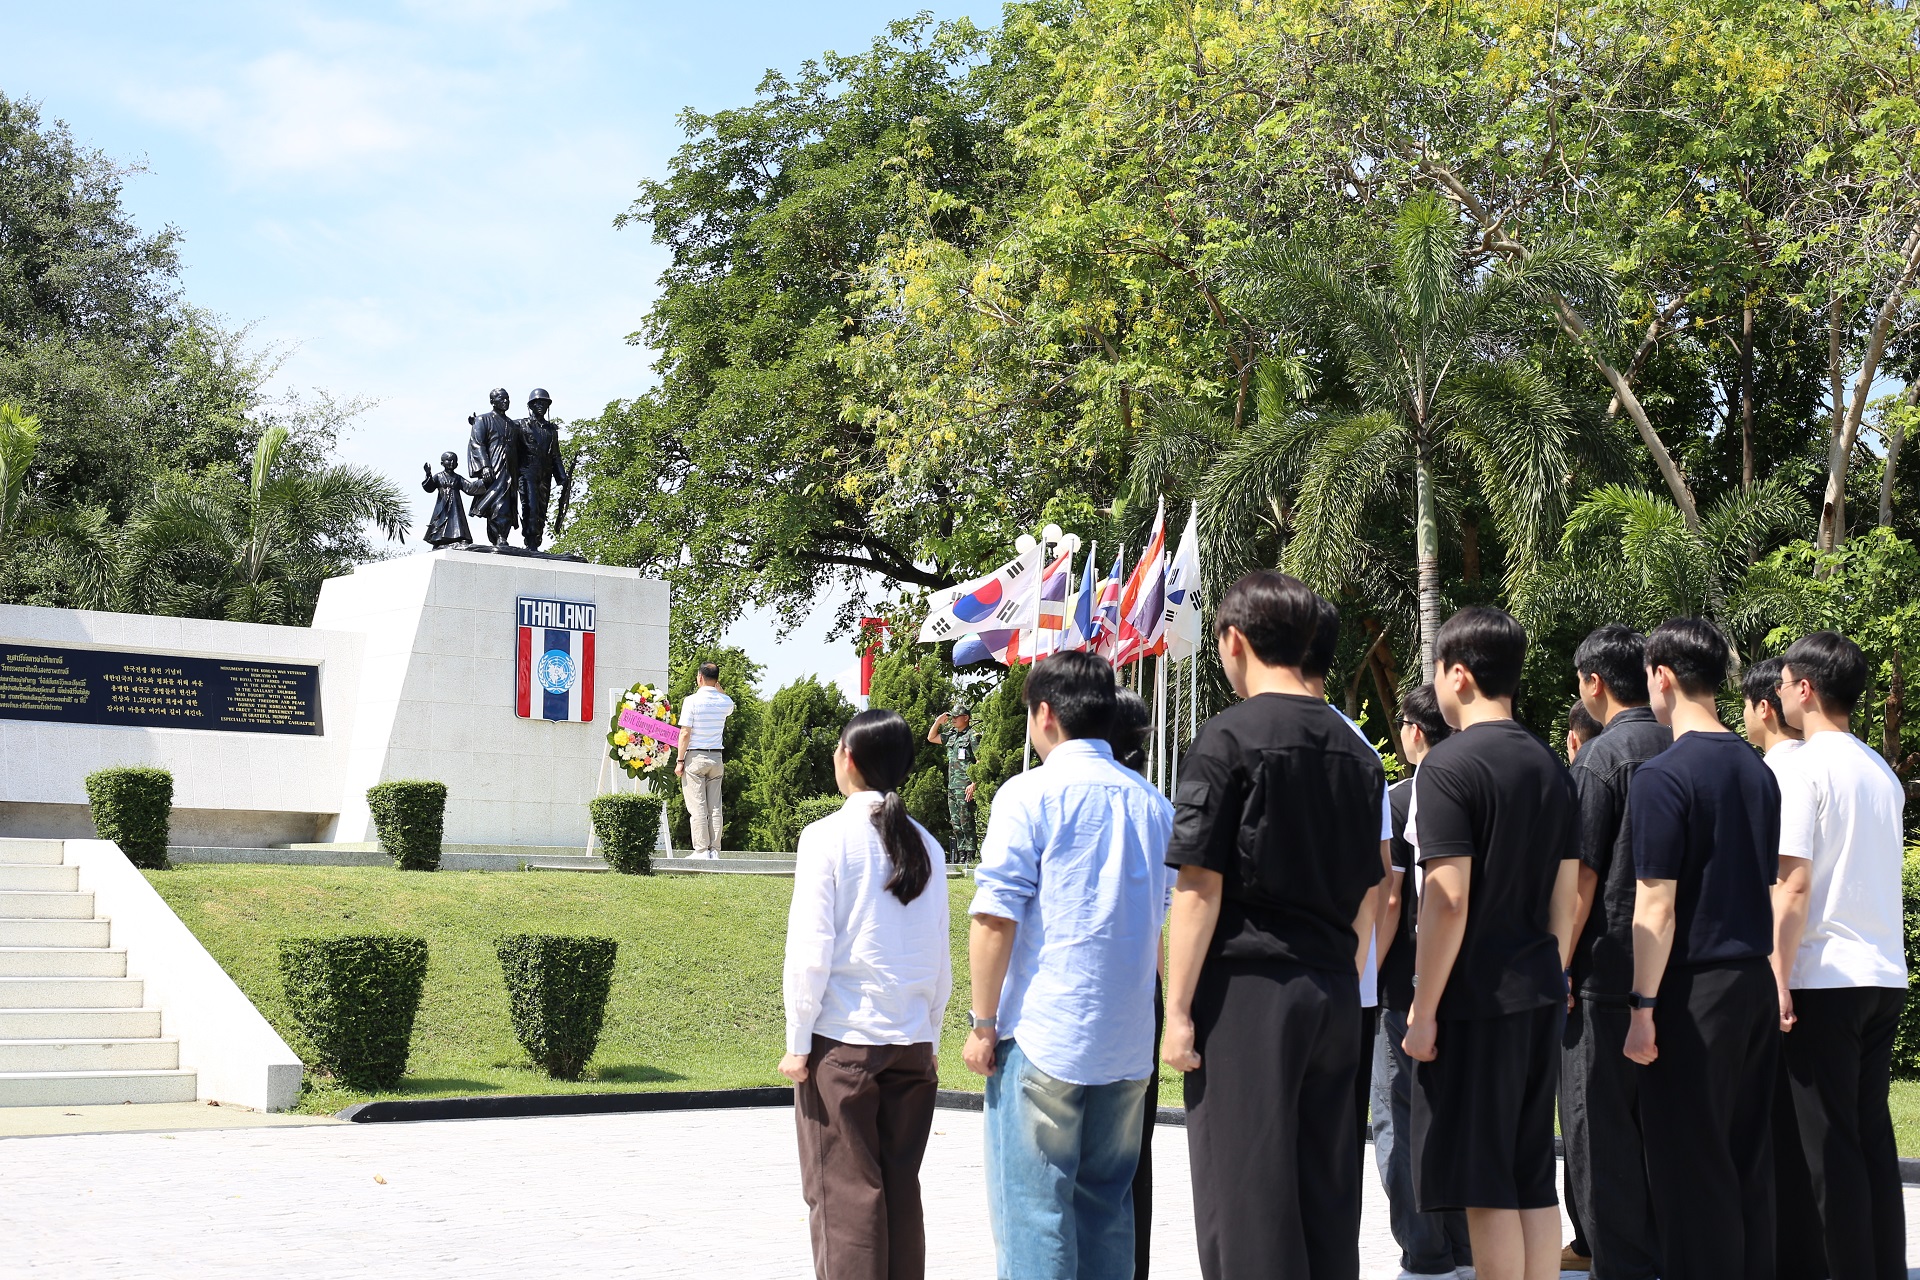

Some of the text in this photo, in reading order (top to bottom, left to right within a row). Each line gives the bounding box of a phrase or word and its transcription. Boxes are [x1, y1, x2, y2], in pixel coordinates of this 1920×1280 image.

[520, 600, 595, 630] THAILAND
[123, 665, 147, 674] 한국전쟁
[103, 674, 132, 682] 대한민국의
[156, 678, 174, 686] 평화를
[153, 687, 176, 695] 장병들의
[133, 696, 162, 705] 1,296명의
